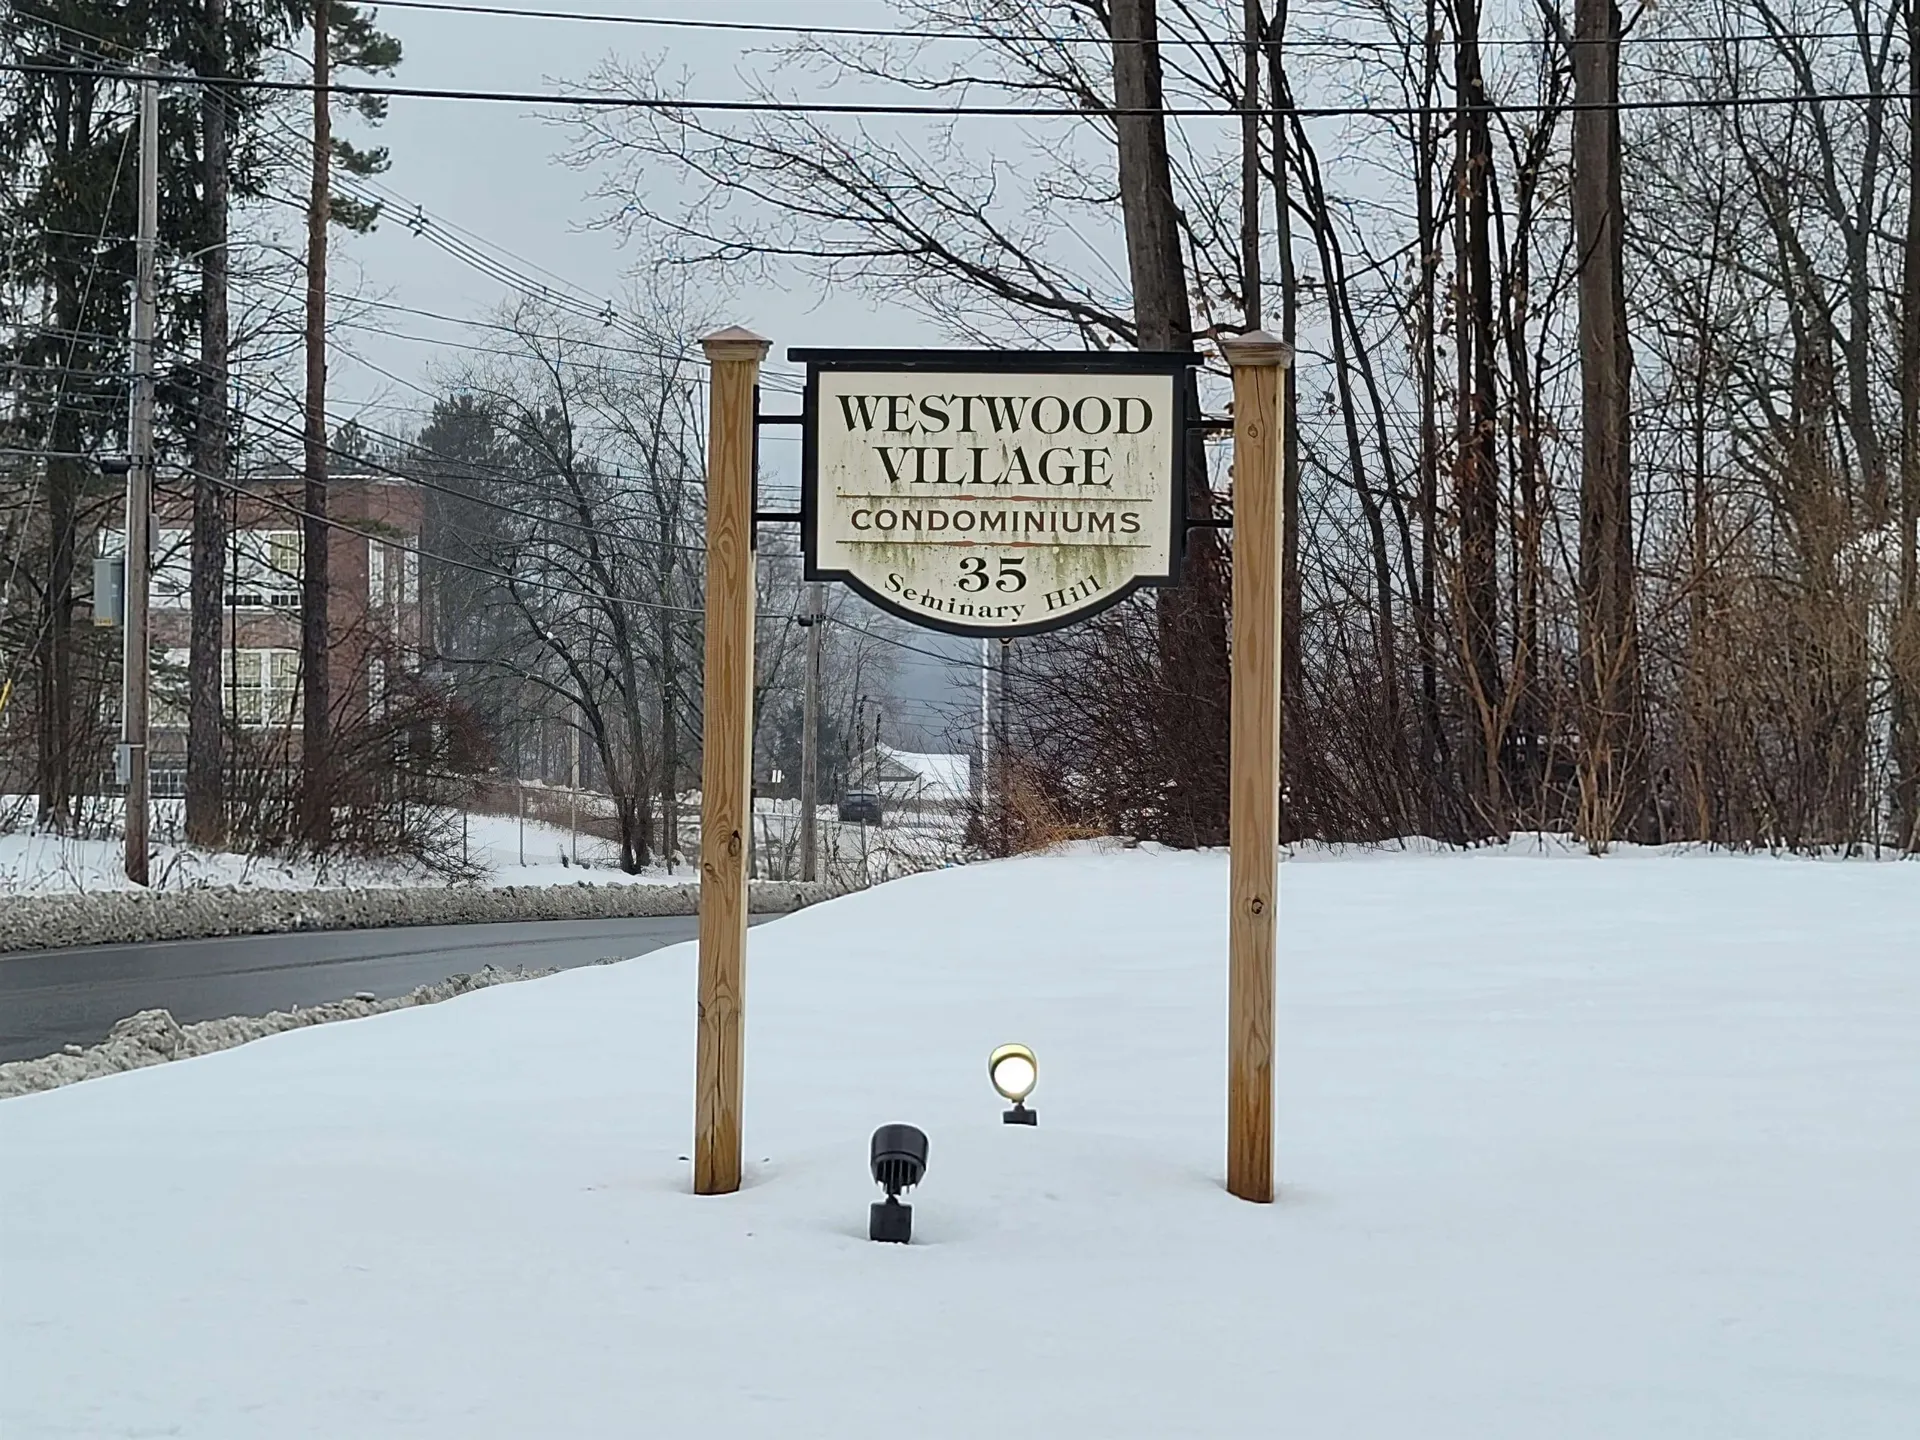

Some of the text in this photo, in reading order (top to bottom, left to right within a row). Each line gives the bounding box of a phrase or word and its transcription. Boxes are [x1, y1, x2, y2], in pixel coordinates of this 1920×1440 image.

[836, 393, 1154, 435] WESTWOOD
[873, 446, 1114, 487] VILLAGE
[851, 508, 1142, 533] CONDOMINIUMS
[958, 556, 1027, 593] 35
[884, 572, 1104, 622] Seminary Hill
